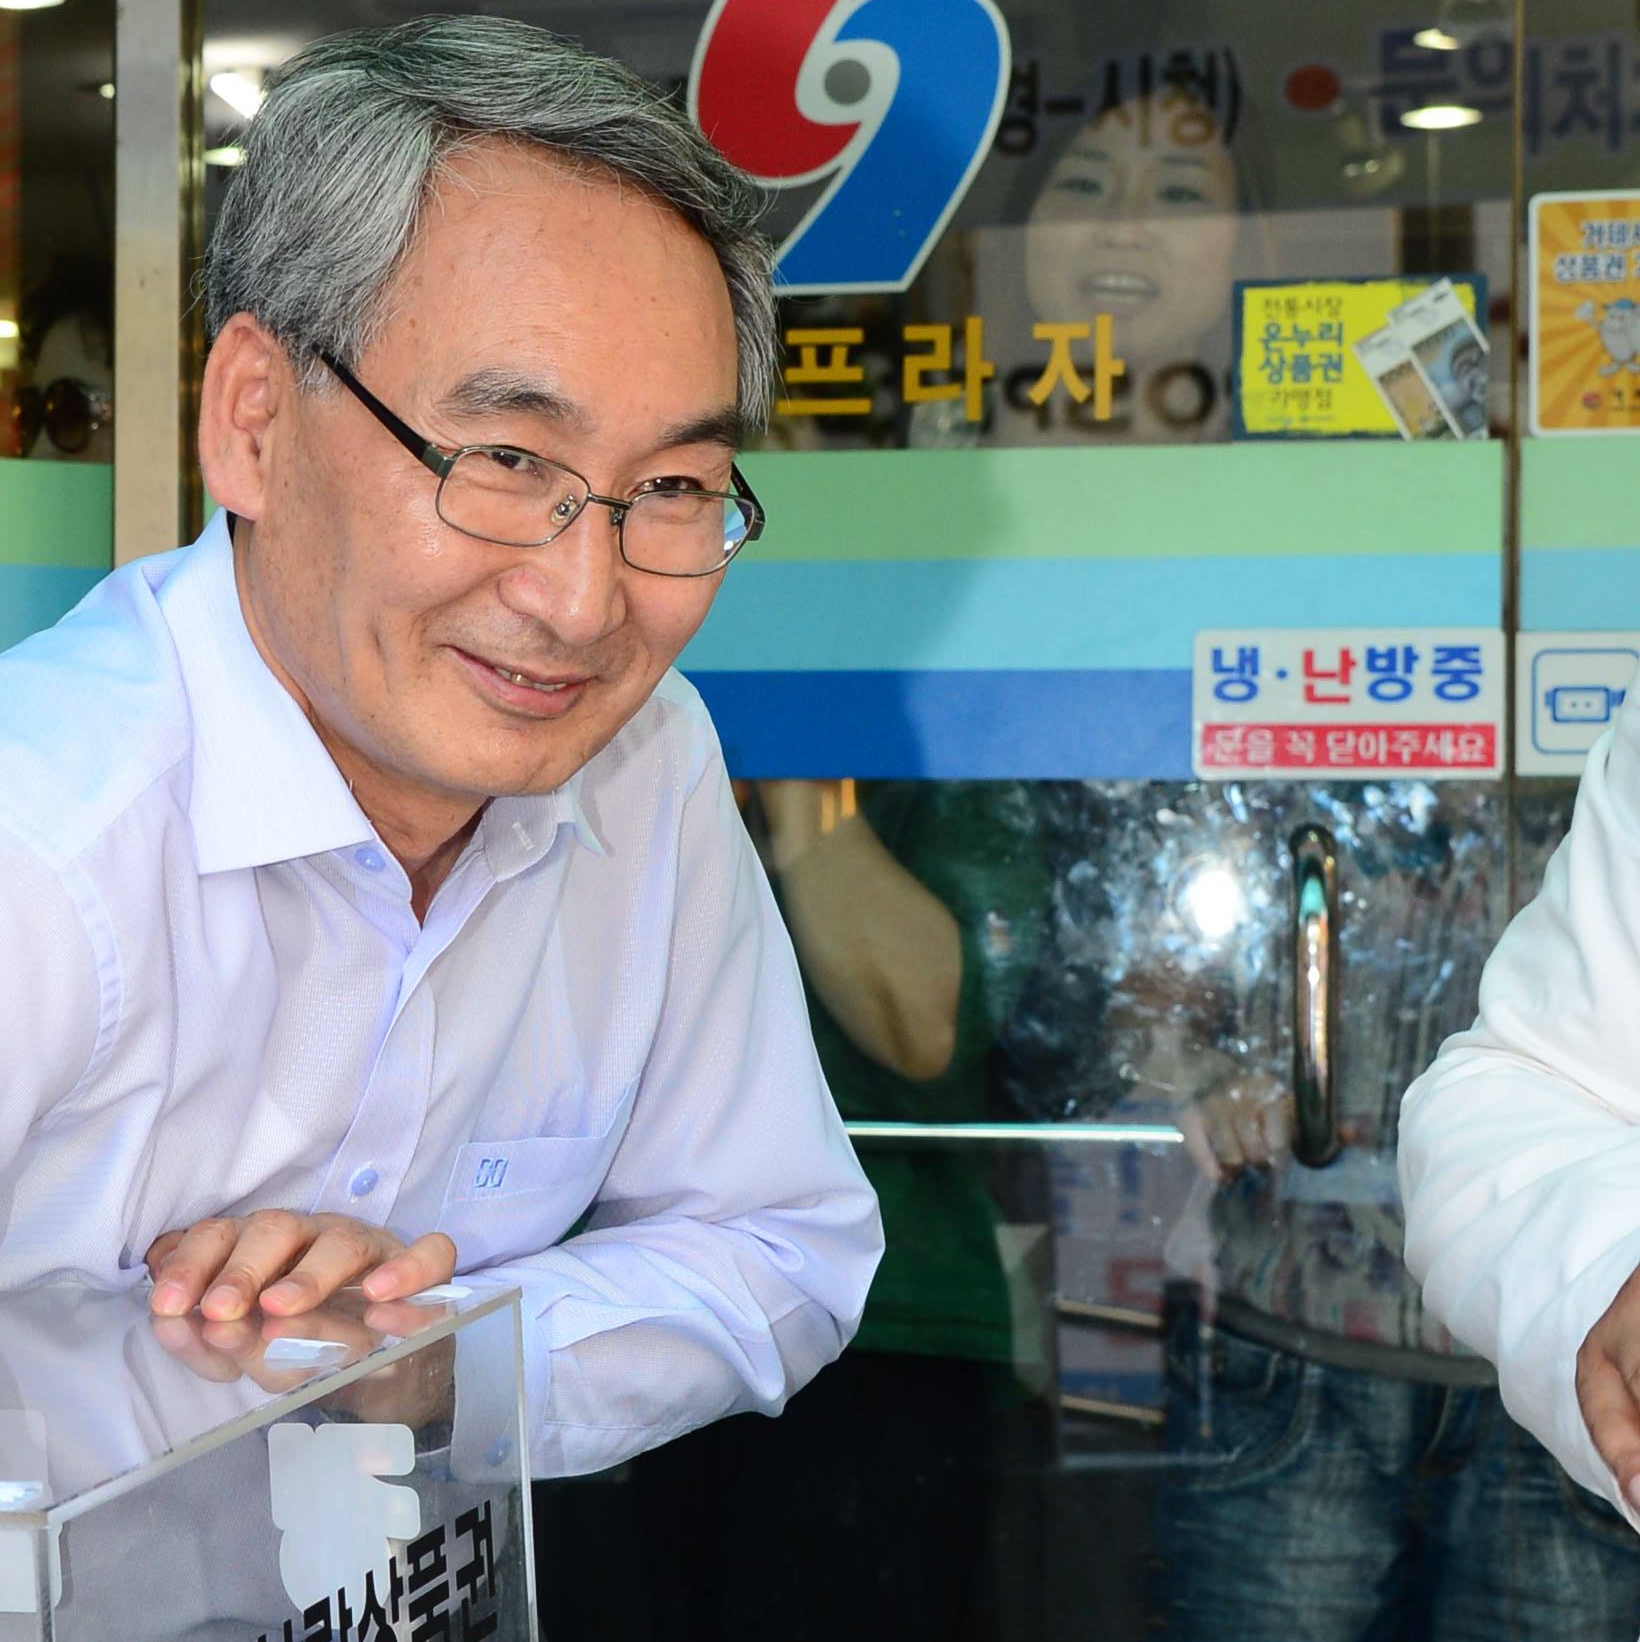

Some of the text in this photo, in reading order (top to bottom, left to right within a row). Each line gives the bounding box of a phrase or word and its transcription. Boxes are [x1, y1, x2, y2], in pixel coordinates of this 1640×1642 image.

[1581, 220, 1640, 248] 거제
[1257, 321, 1344, 353] 온누리
[1259, 352, 1344, 385] 상품권
[1212, 726, 1487, 765] 문을 꼭 닫아주세요
